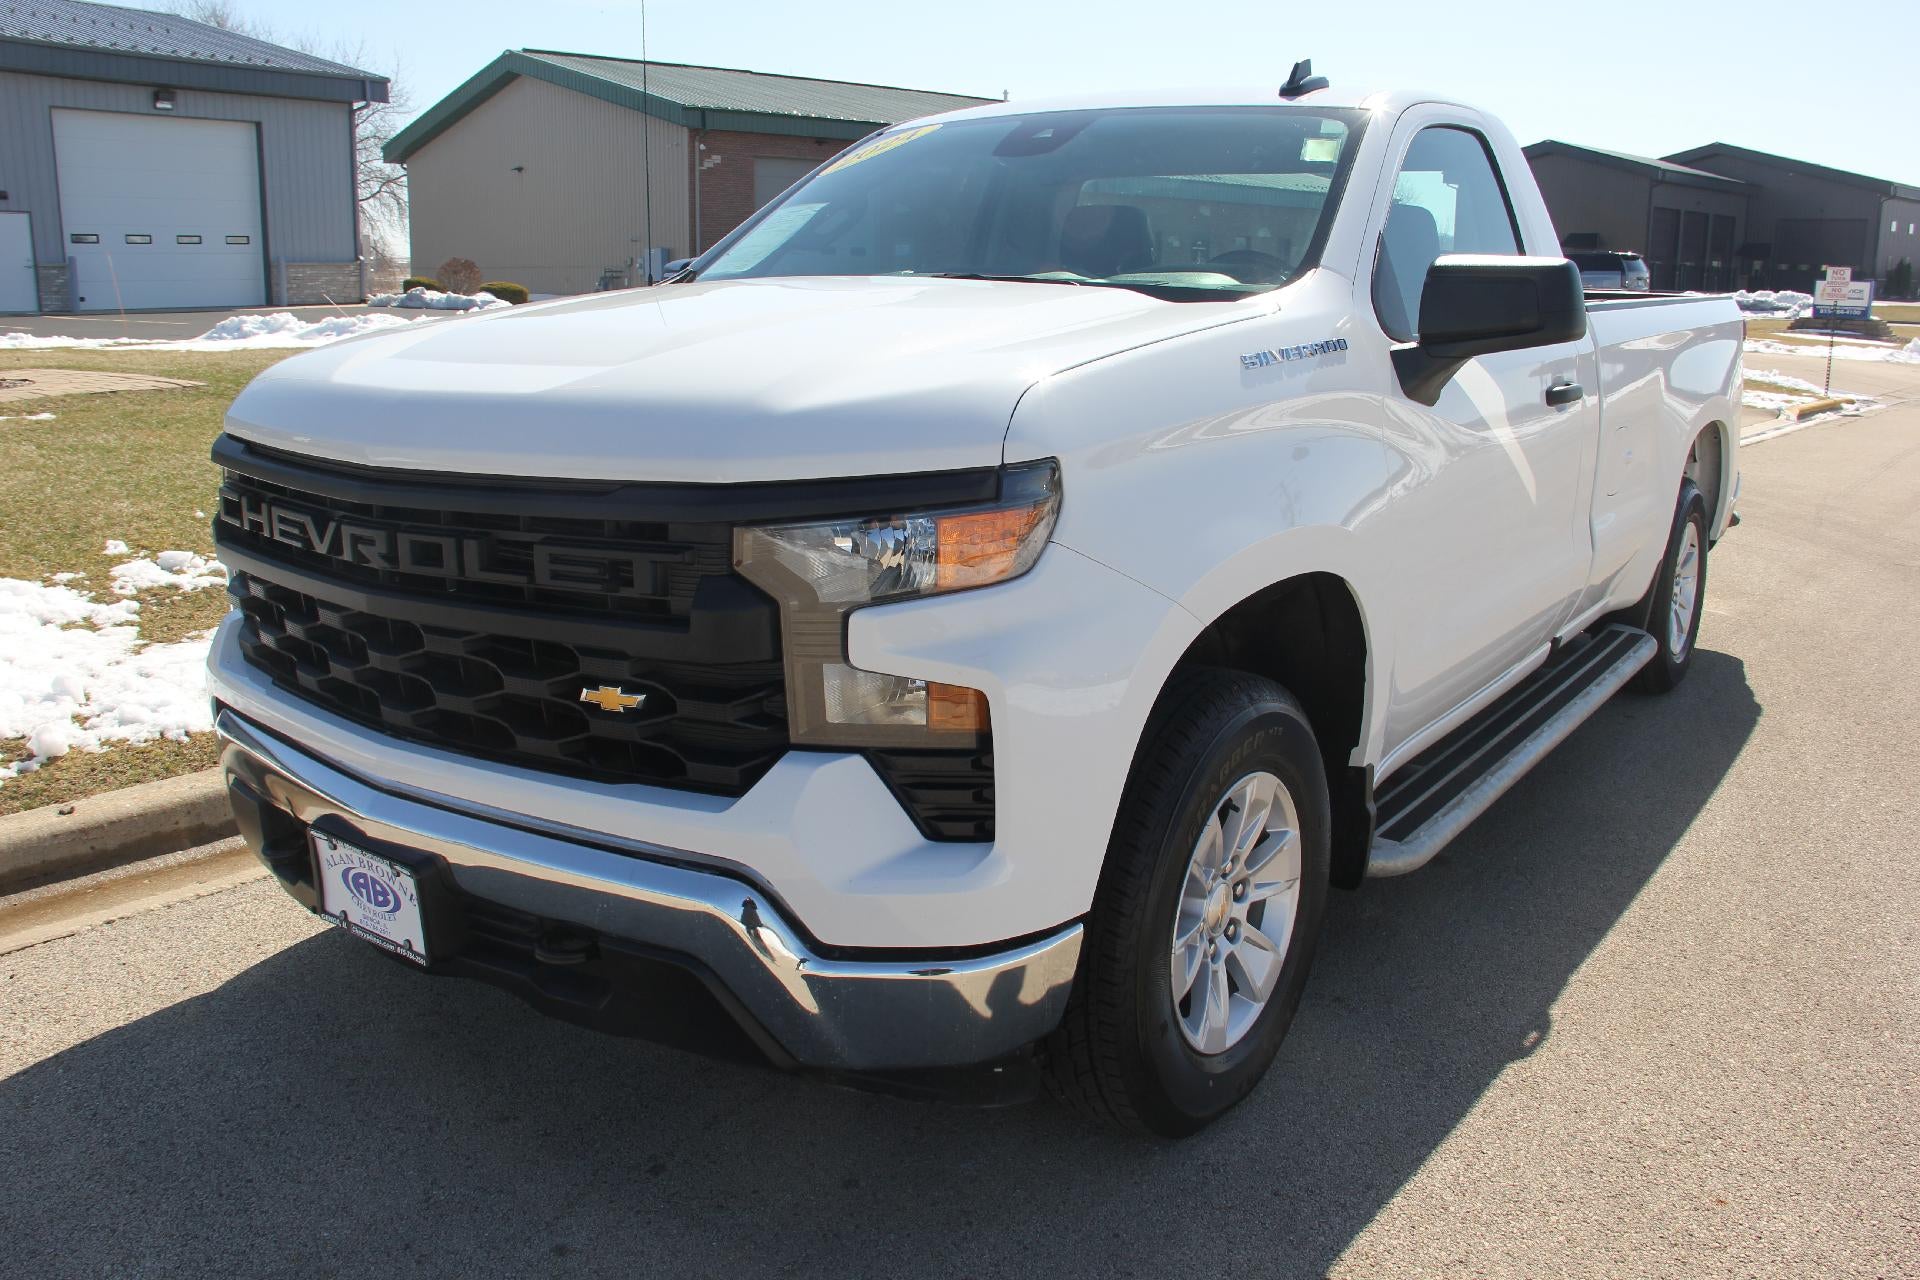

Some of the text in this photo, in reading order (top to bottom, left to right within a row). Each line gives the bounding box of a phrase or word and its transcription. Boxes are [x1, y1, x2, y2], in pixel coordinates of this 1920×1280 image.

[1240, 338, 1348, 369] SILVERADO
[218, 488, 692, 597] CHEVROLET
[325, 853, 417, 908] ALAN BROWNE
